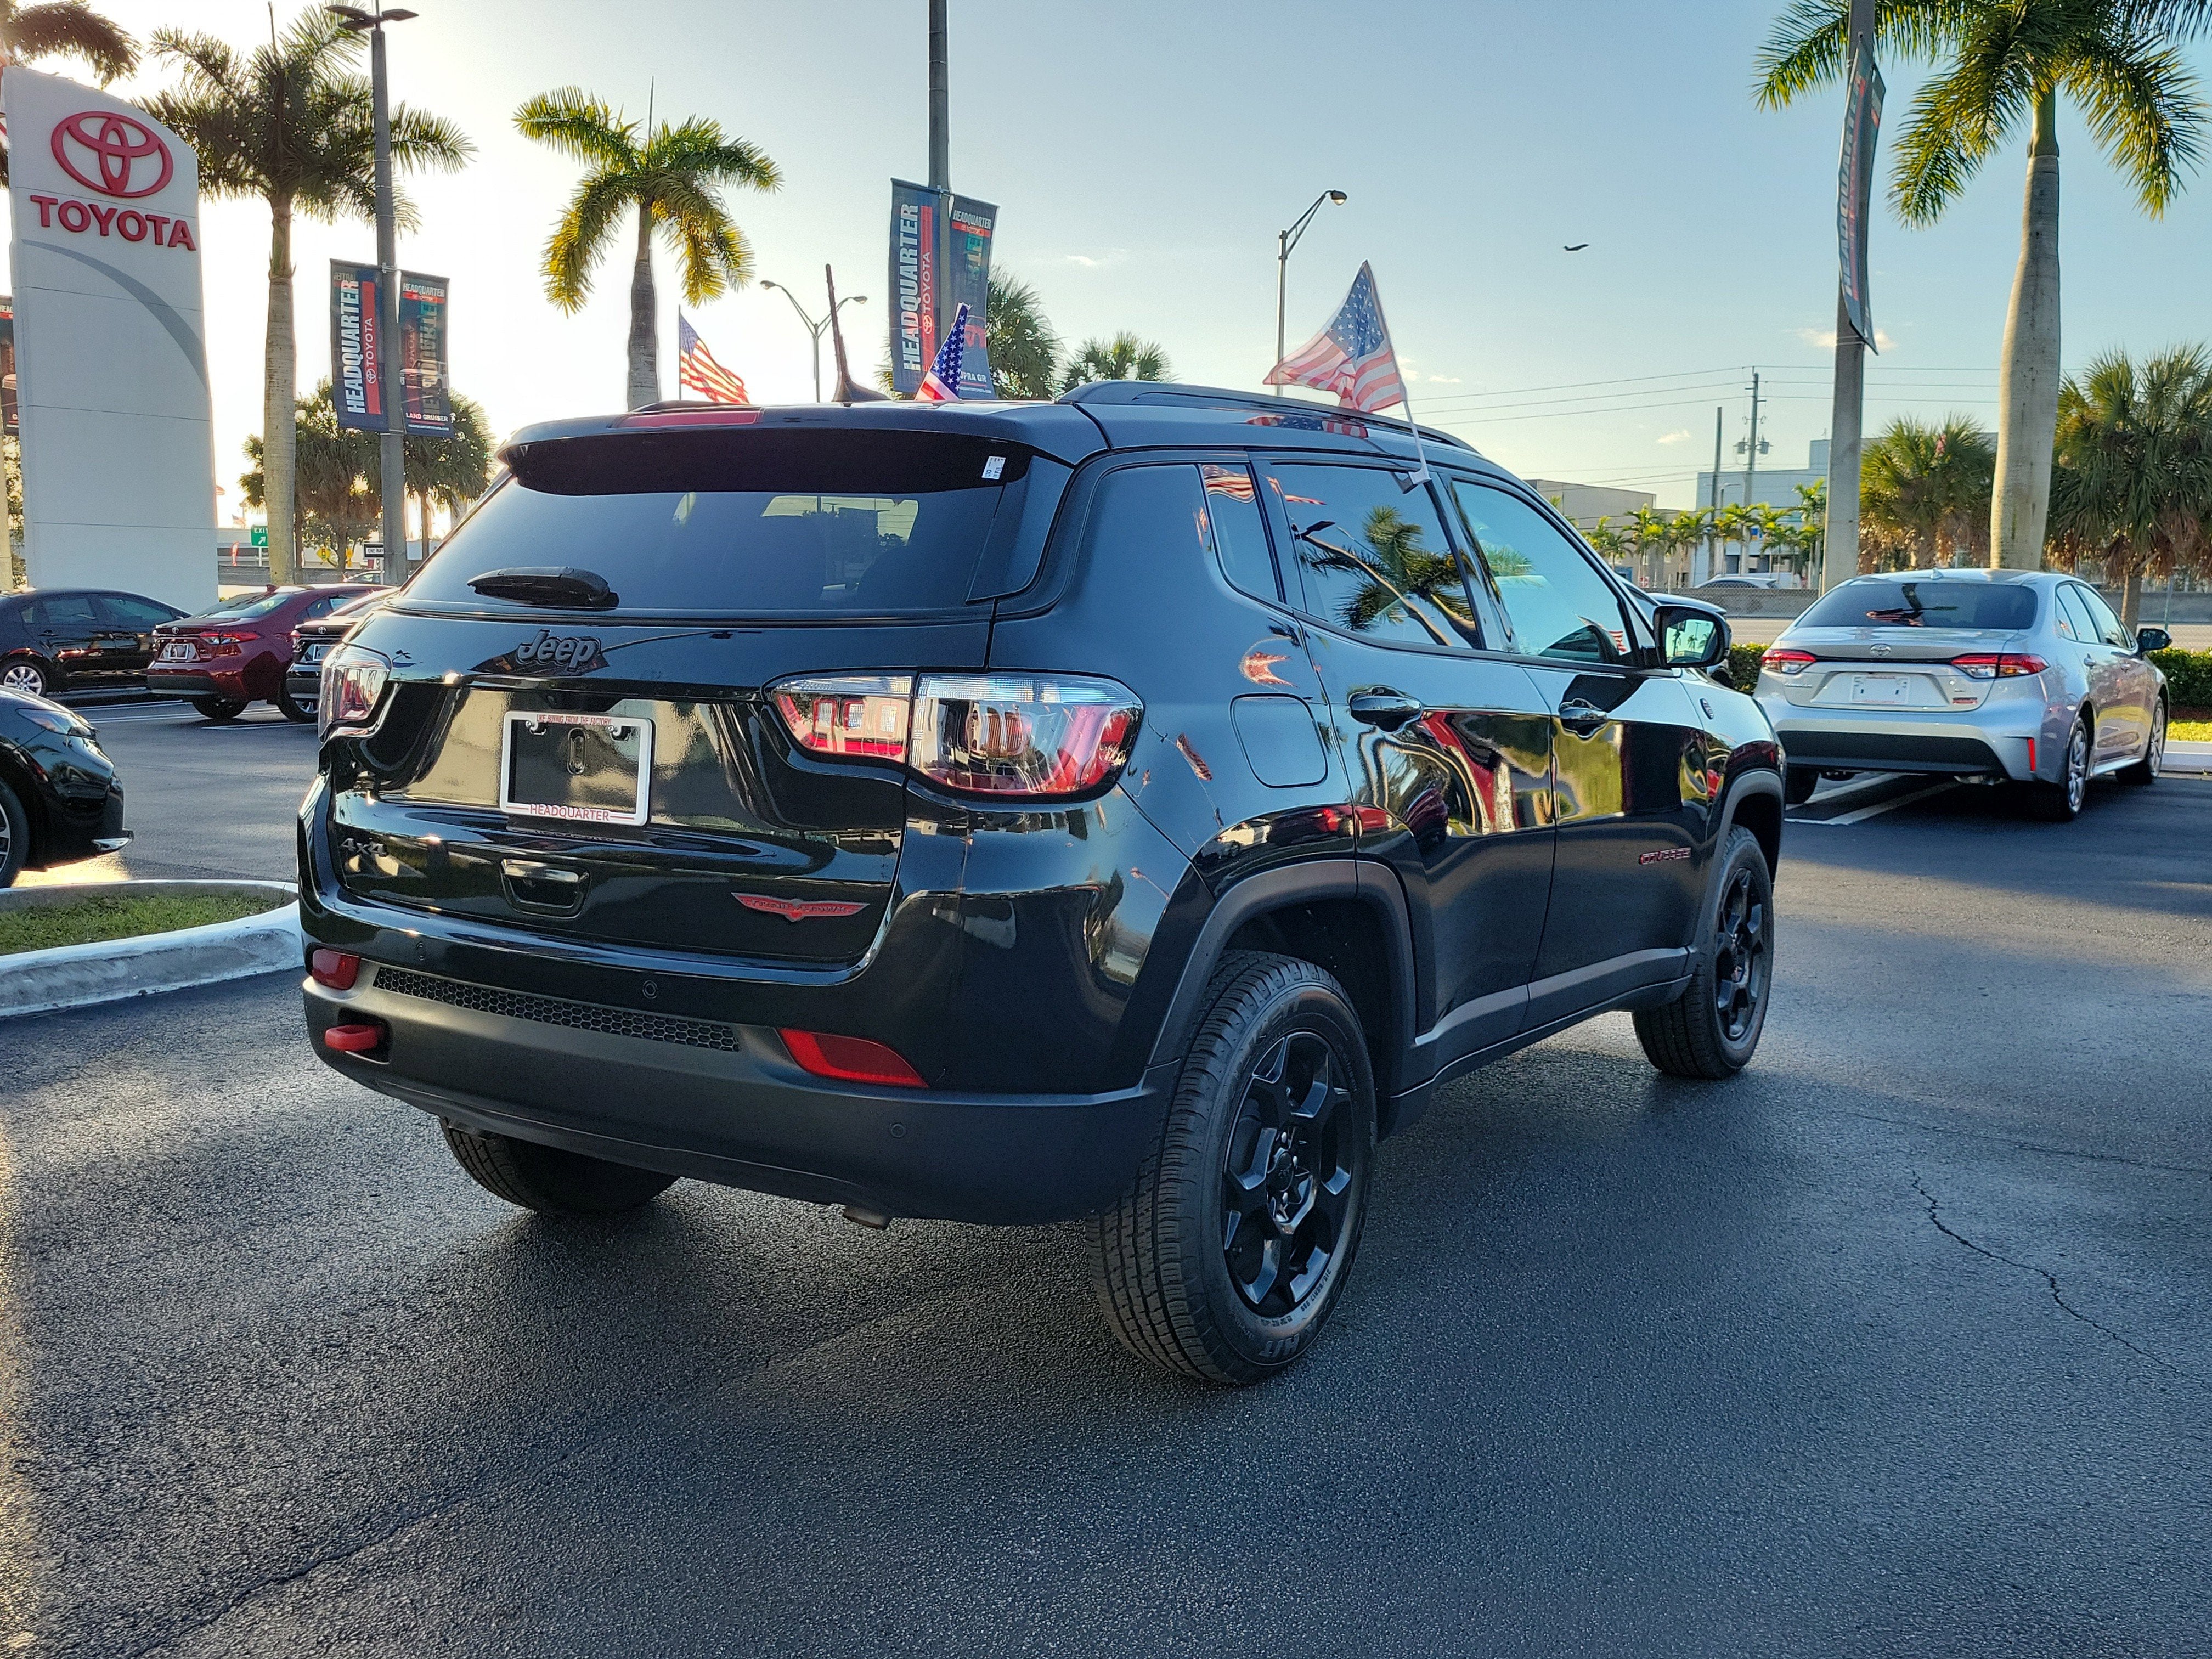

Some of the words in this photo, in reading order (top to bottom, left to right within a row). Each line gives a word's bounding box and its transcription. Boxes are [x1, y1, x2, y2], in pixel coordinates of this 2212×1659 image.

[30, 195, 196, 251] TOYOTA
[953, 210, 991, 229] HEADQUARTER
[403, 283, 444, 297] HEADQUARTER
[900, 204, 921, 371] HEADQUARTER
[341, 280, 365, 413] HEADQUARTER
[365, 318, 374, 367] TOYOTA
[960, 371, 976, 381] UPRA
[977, 374, 986, 382] GR
[516, 629, 601, 672] Jeep
[530, 804, 610, 821] HEADQUARTER
